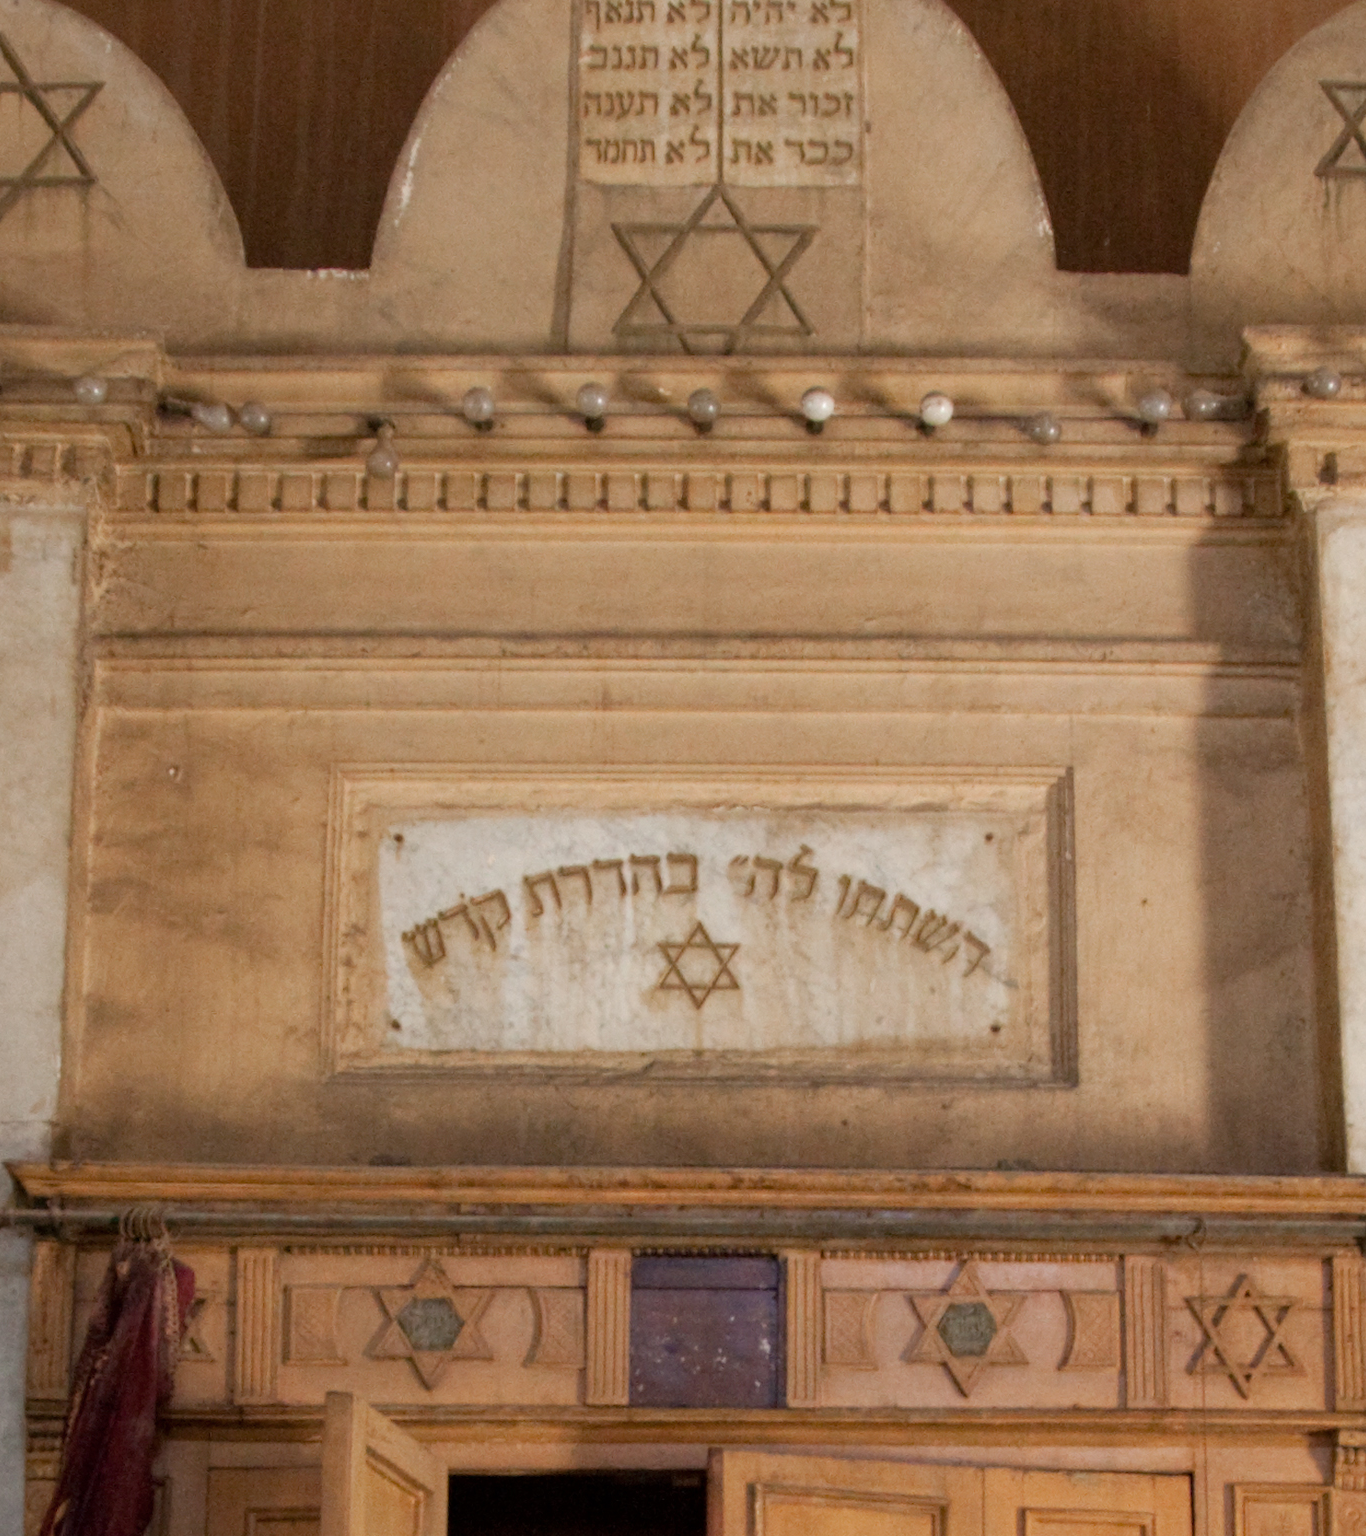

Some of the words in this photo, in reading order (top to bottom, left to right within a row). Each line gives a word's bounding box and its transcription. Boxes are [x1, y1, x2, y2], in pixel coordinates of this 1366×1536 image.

[730, 0, 796, 25] יהיה
[669, 33, 710, 70] לא
[729, 46, 803, 71] תשא
[812, 31, 854, 71] לא
[583, 90, 658, 121] תענה
[669, 79, 712, 116] לא
[731, 91, 777, 117] את
[788, 91, 854, 117] זכור
[585, 138, 655, 164] תחמד
[665, 124, 710, 164] לא
[730, 138, 774, 165] את
